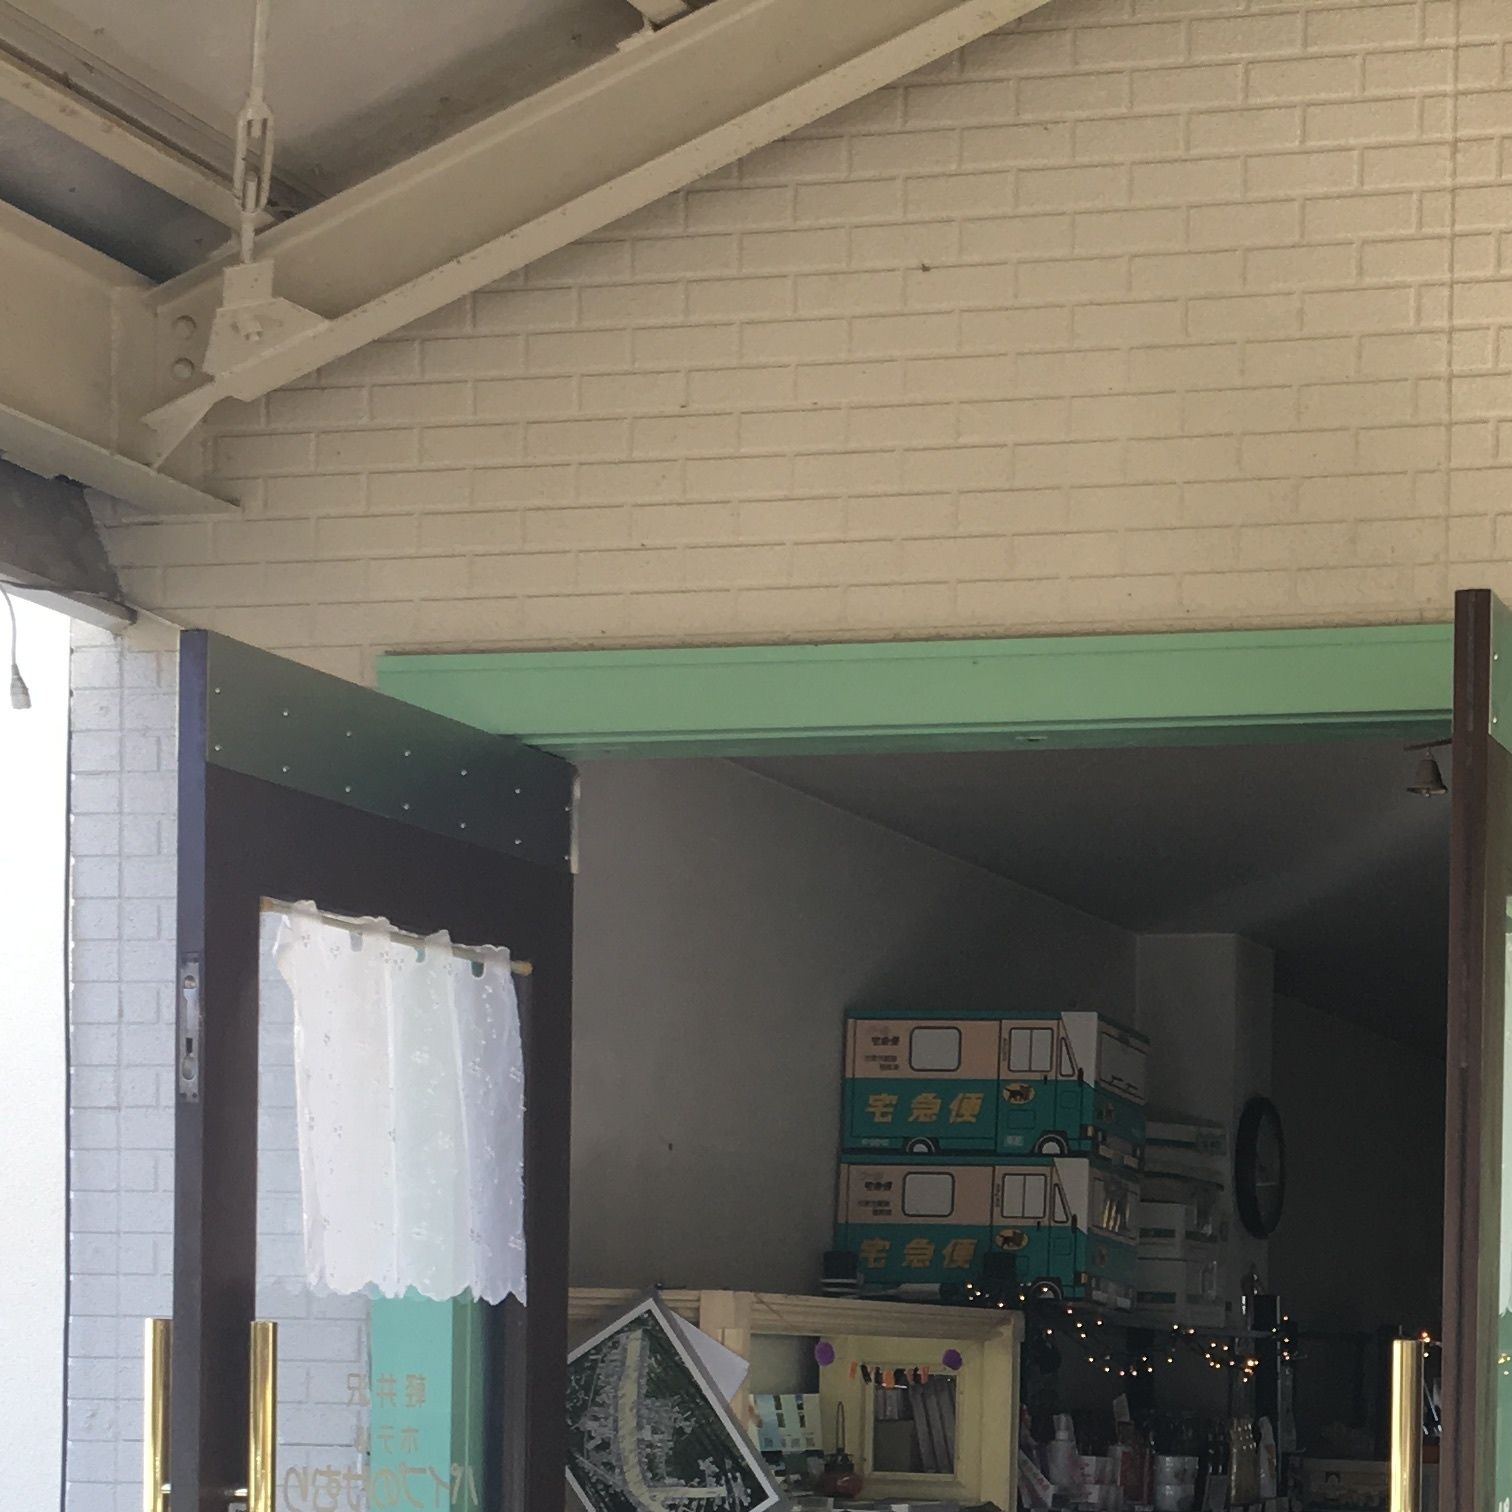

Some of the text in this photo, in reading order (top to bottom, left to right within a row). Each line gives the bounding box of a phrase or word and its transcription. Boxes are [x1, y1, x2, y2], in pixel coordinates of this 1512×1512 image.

[866, 1092, 983, 1123] 宅急便
[860, 1238, 977, 1268] 宅急便
